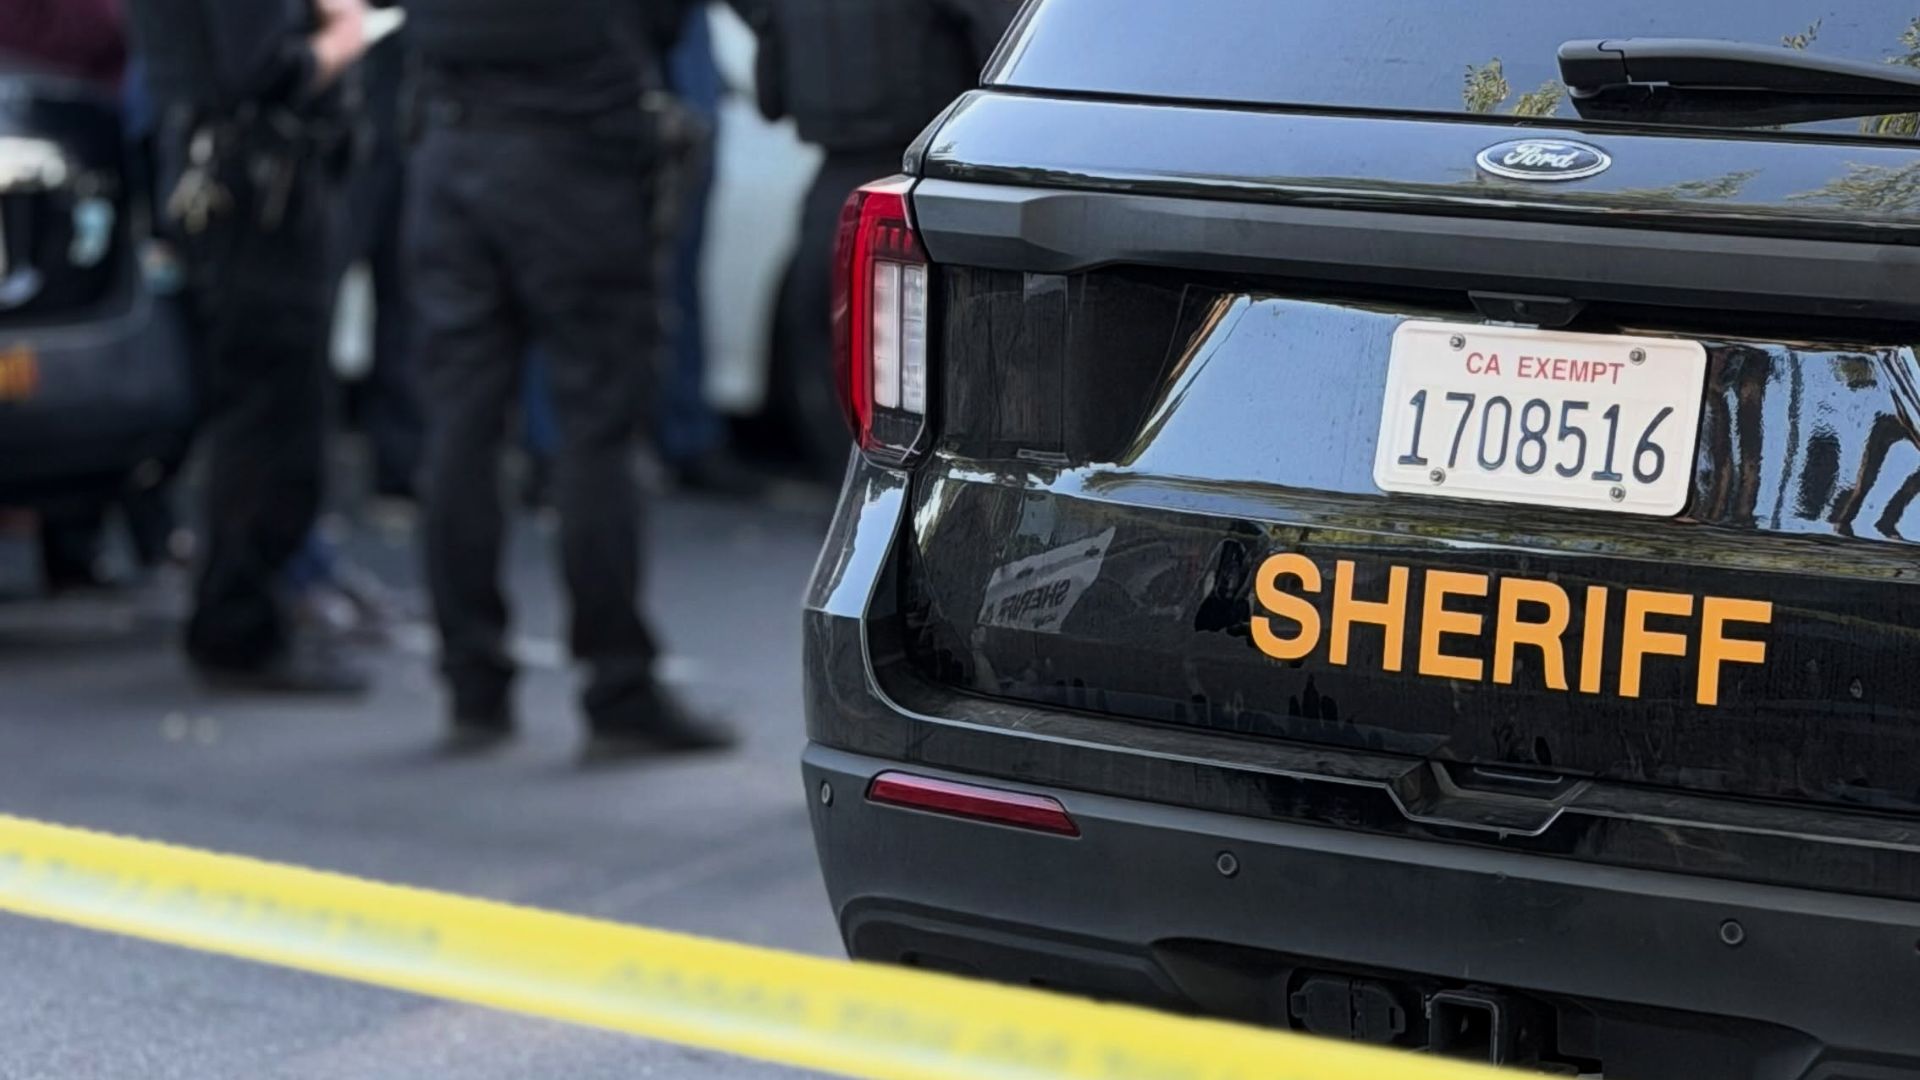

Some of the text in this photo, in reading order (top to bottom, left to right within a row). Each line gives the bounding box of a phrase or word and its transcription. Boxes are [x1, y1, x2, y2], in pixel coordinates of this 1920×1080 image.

[1503, 143, 1581, 168] Ford
[1466, 352, 1625, 385] CA EXEMPT
[1398, 389, 1674, 484] 1708516
[1250, 552, 1773, 706] SHERIFF
